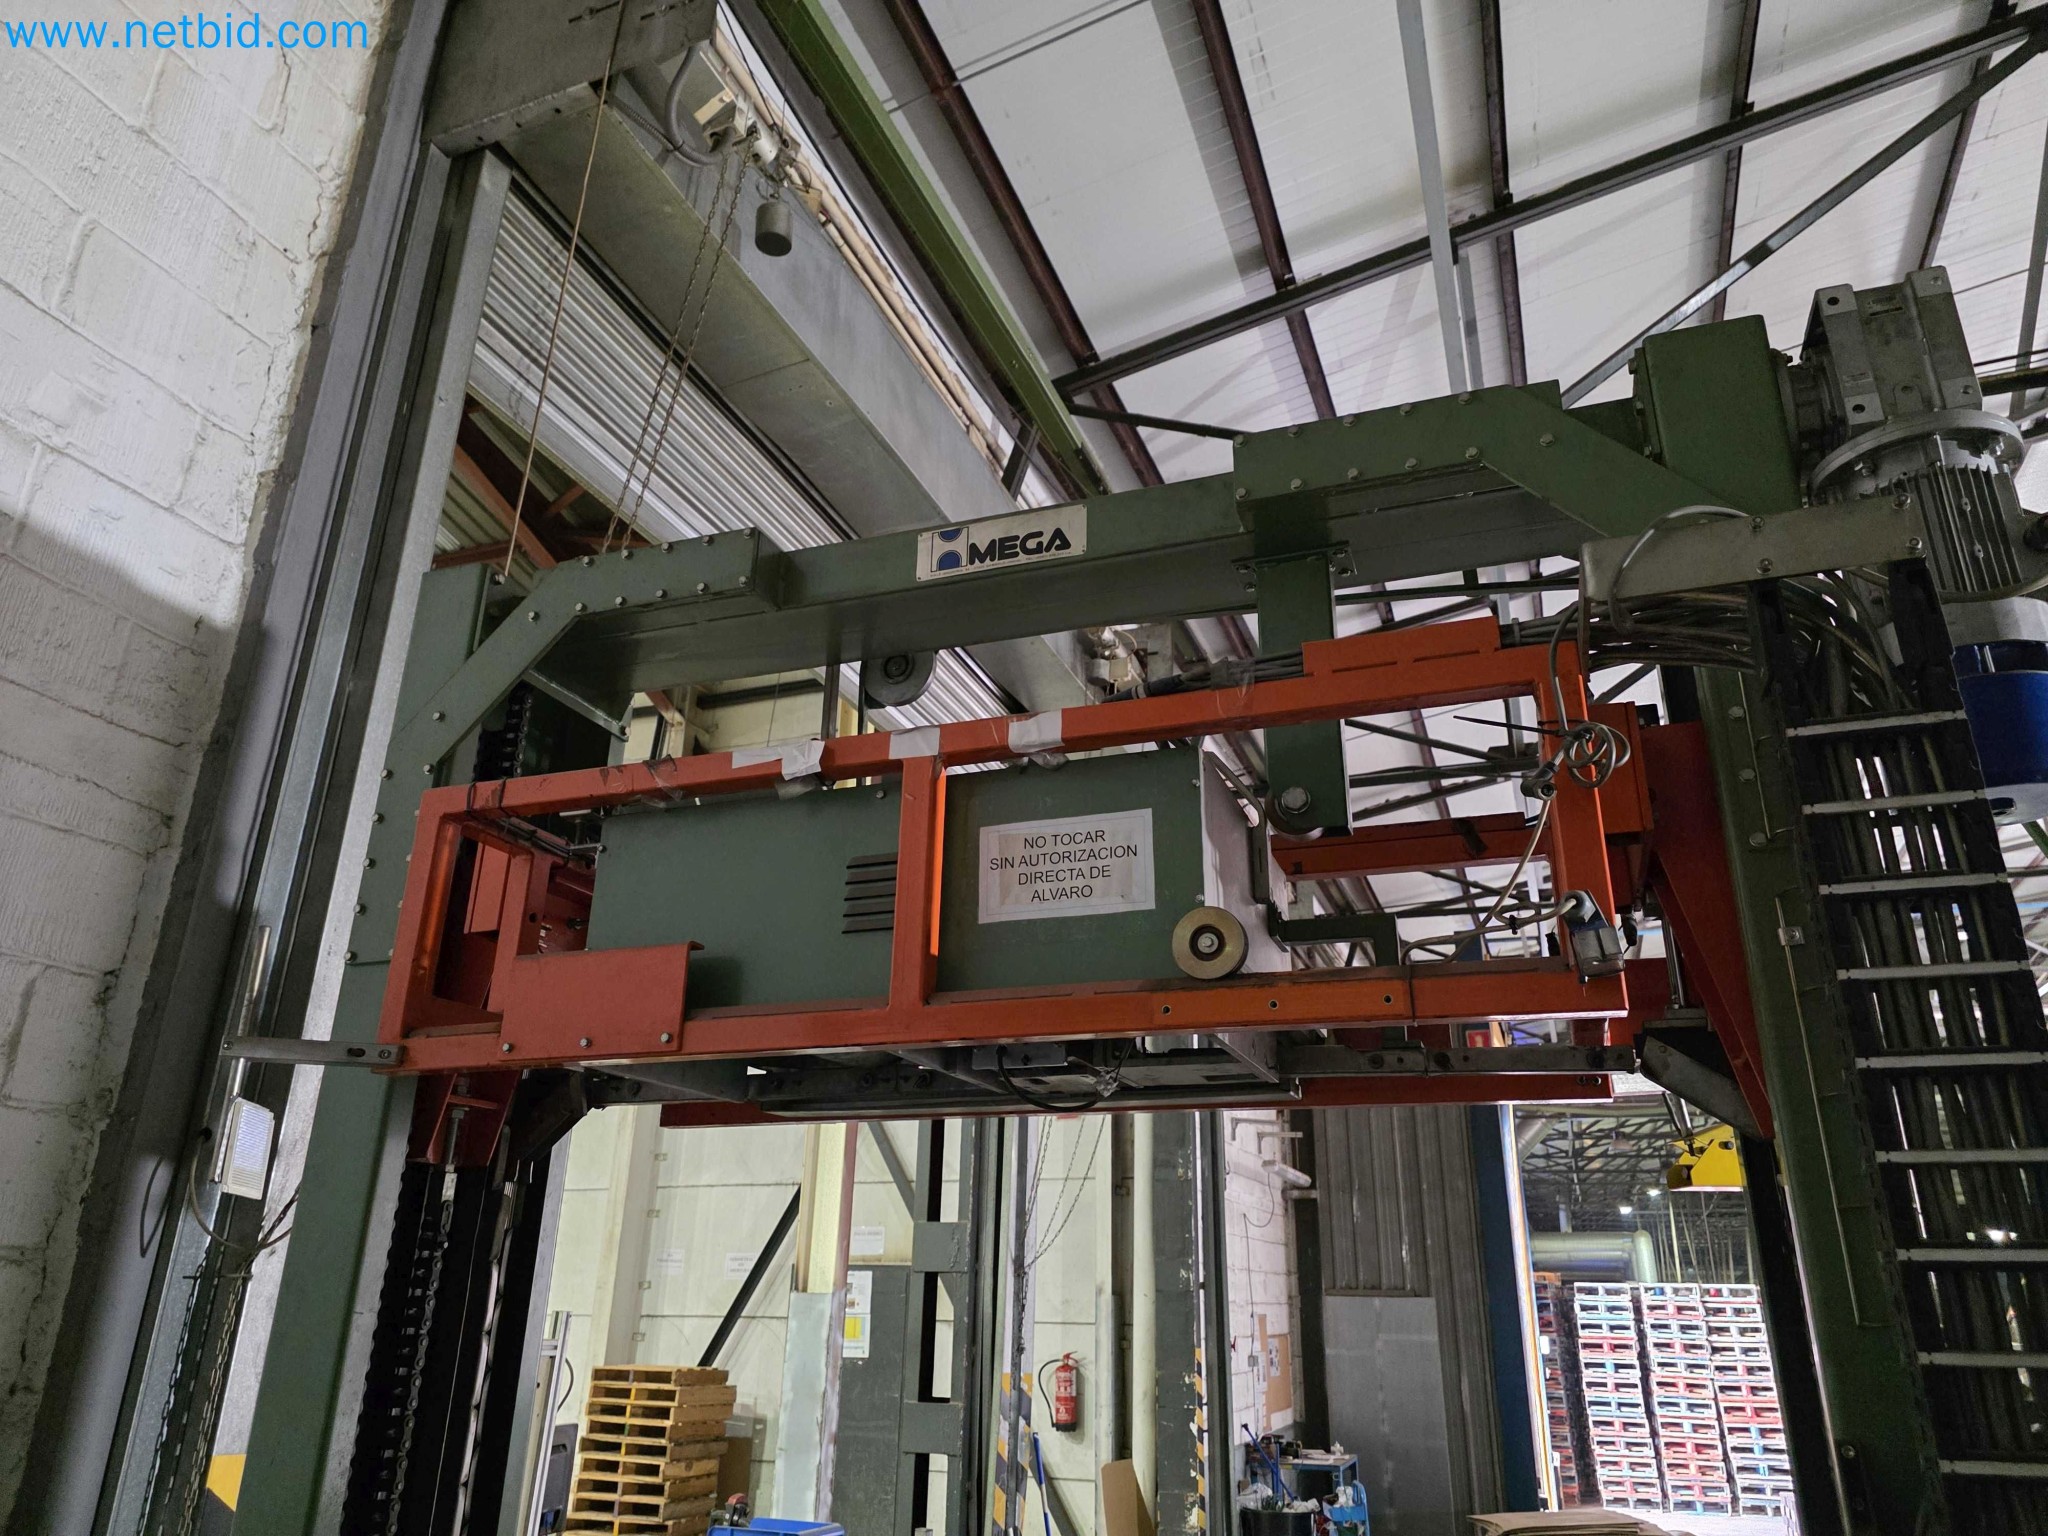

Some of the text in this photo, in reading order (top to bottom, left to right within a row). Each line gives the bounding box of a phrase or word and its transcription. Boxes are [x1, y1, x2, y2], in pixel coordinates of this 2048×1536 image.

[1024, 829, 1106, 850] NO TOCAR
[989, 844, 1138, 871] SIN AUTORIZACION
[1018, 865, 1112, 886] DIRECTA DE
[1031, 885, 1093, 903] ALVARO
